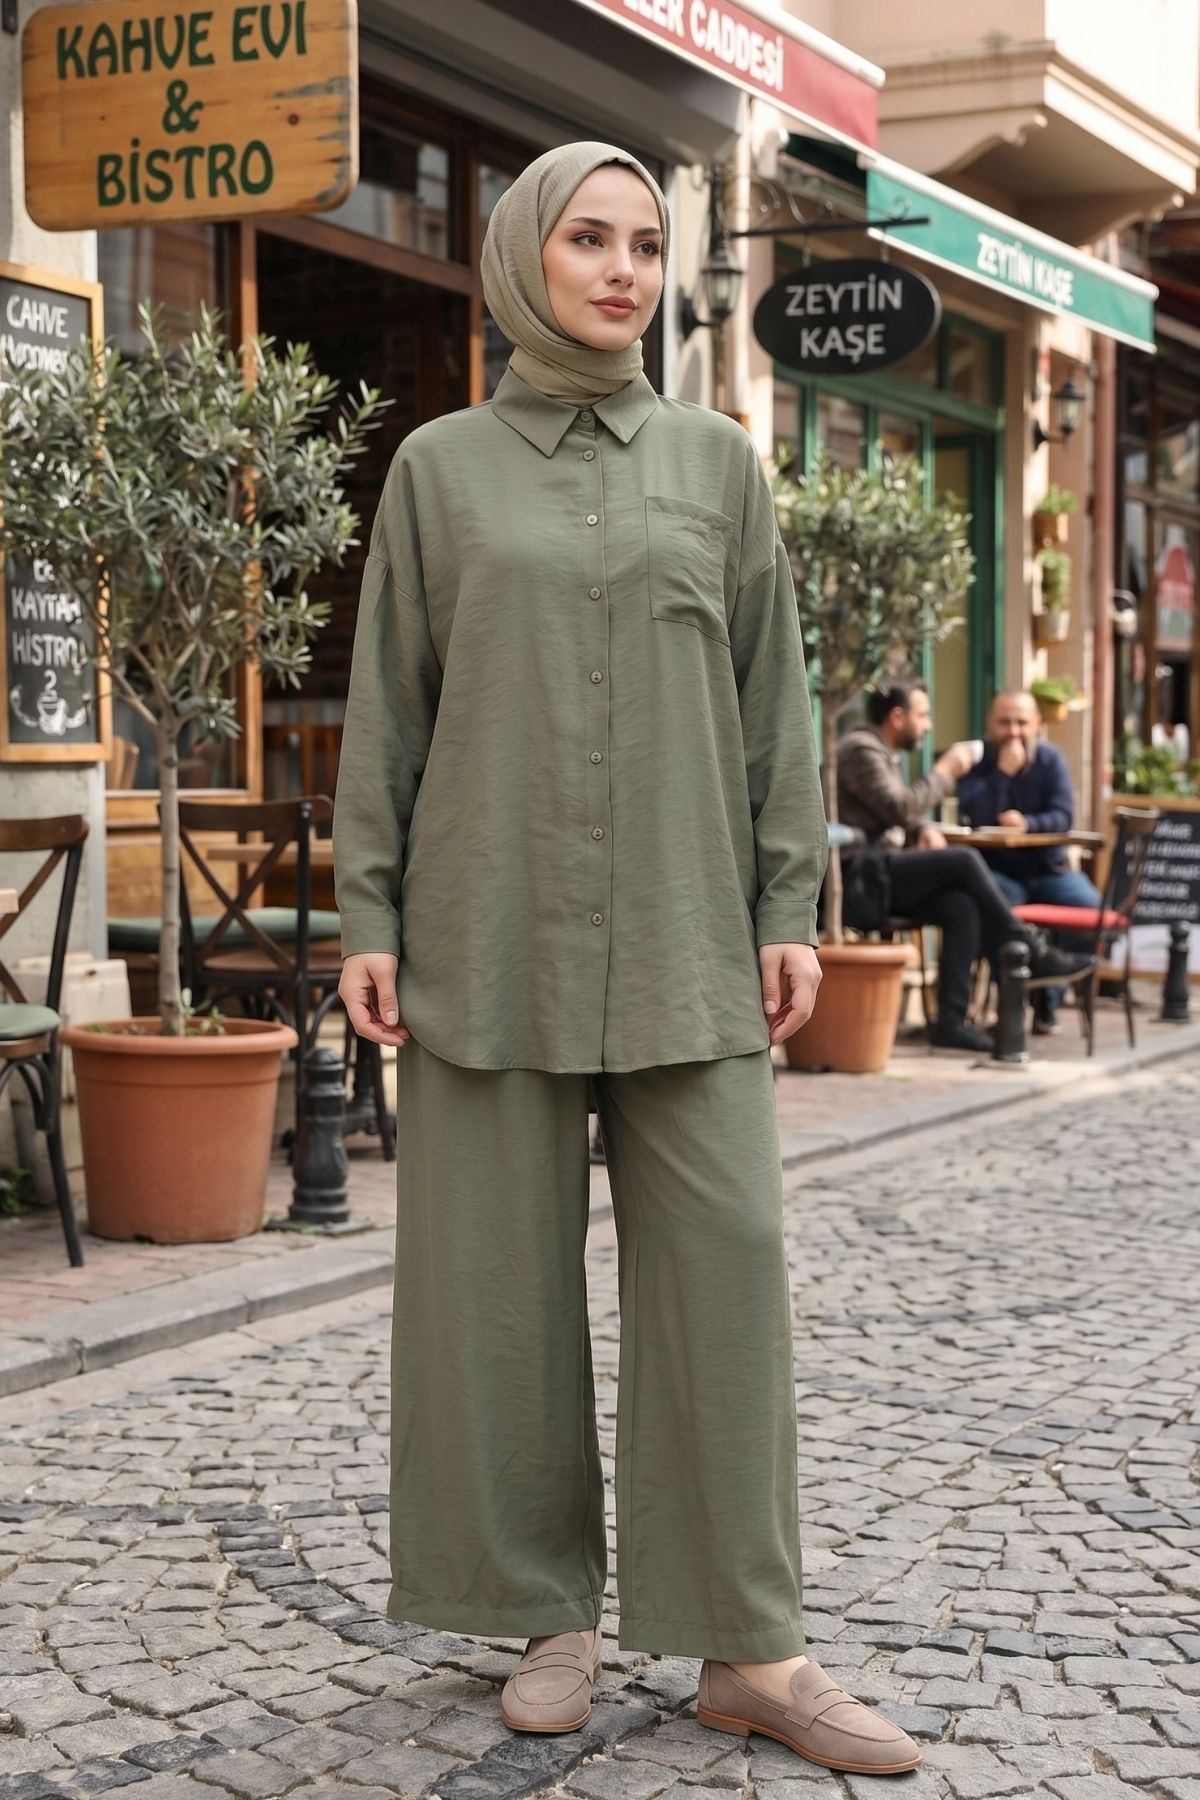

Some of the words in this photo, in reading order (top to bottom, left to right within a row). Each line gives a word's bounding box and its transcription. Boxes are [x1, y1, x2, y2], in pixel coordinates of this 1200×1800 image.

[57, 11, 216, 80] KAHVE
[689, 0, 785, 92] CADDESİ
[162, 79, 205, 134] &
[96, 137, 275, 208] BİSTRO
[785, 272, 903, 317] ZEYTİN
[977, 231, 1034, 291] ZEYTİN
[1034, 257, 1075, 309] KAŞE
[800, 323, 888, 365] KAŞE
